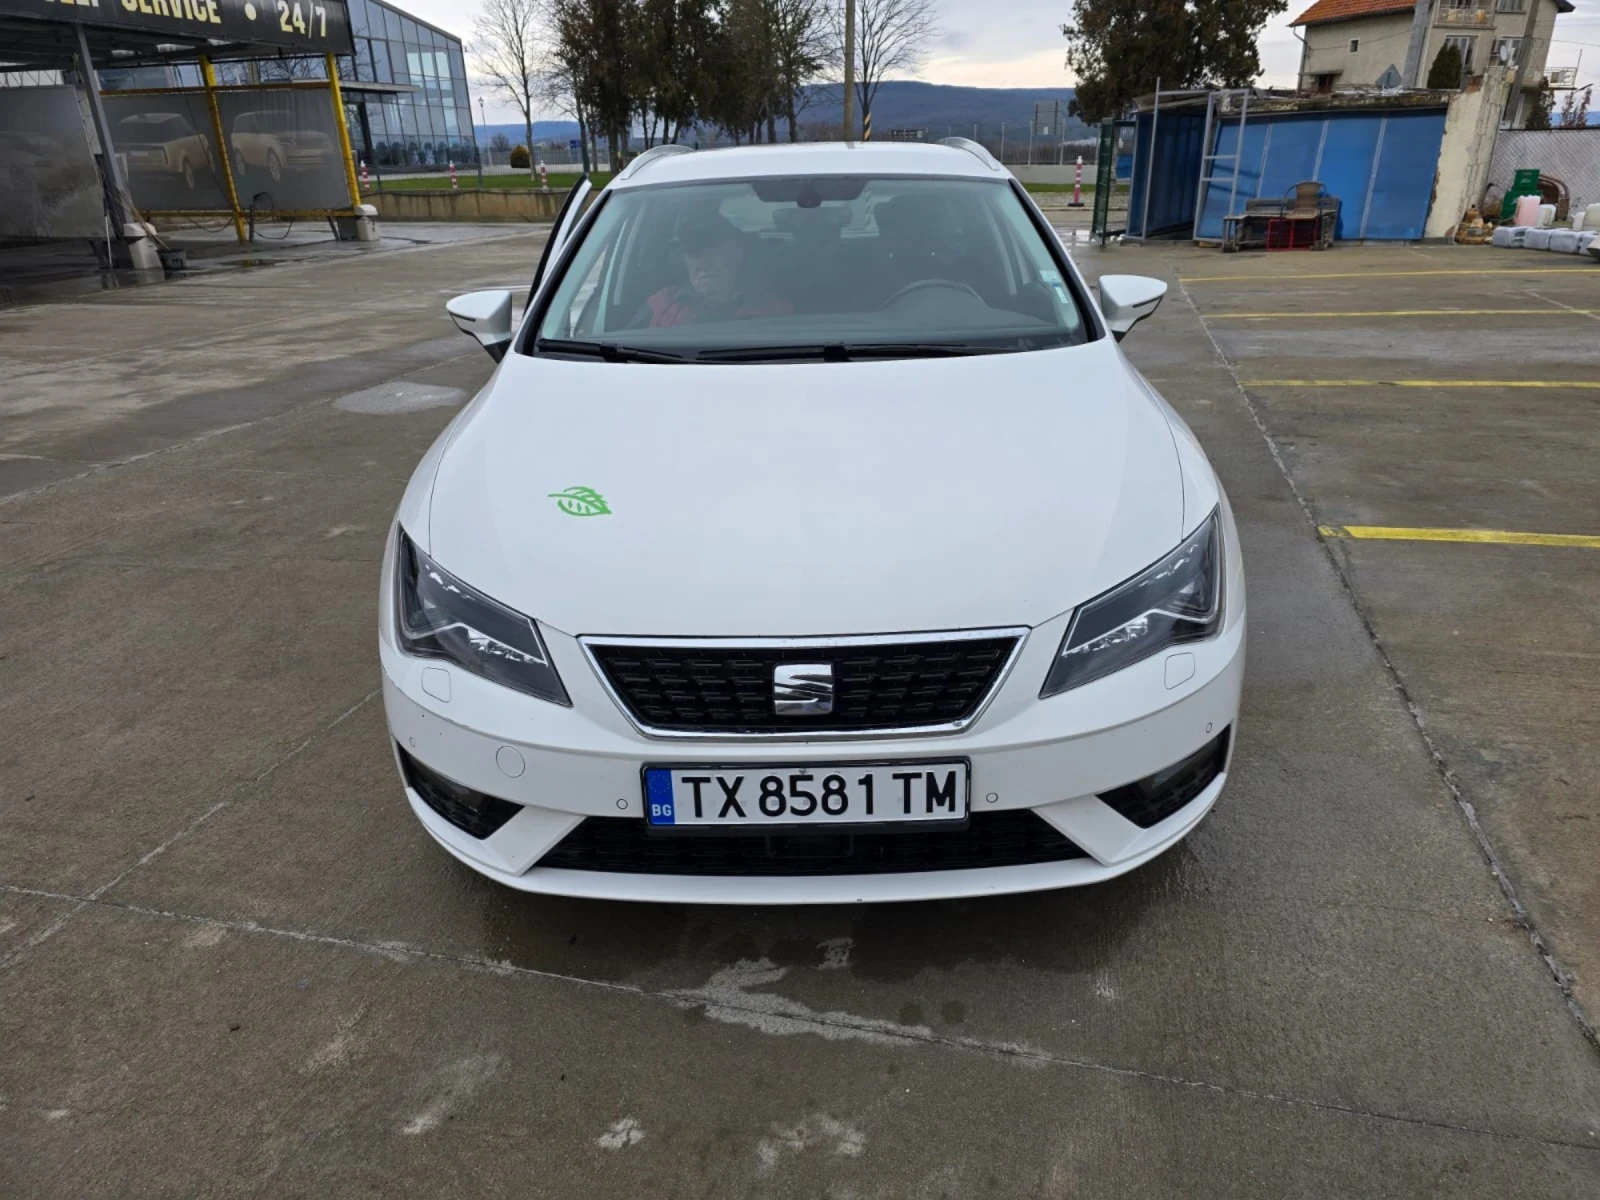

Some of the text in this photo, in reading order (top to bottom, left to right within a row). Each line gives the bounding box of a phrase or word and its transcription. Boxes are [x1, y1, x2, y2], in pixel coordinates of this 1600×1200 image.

[277, 0, 326, 39] 24/7
[652, 804, 671, 817] BG
[681, 770, 957, 818] TX 8581 TM
